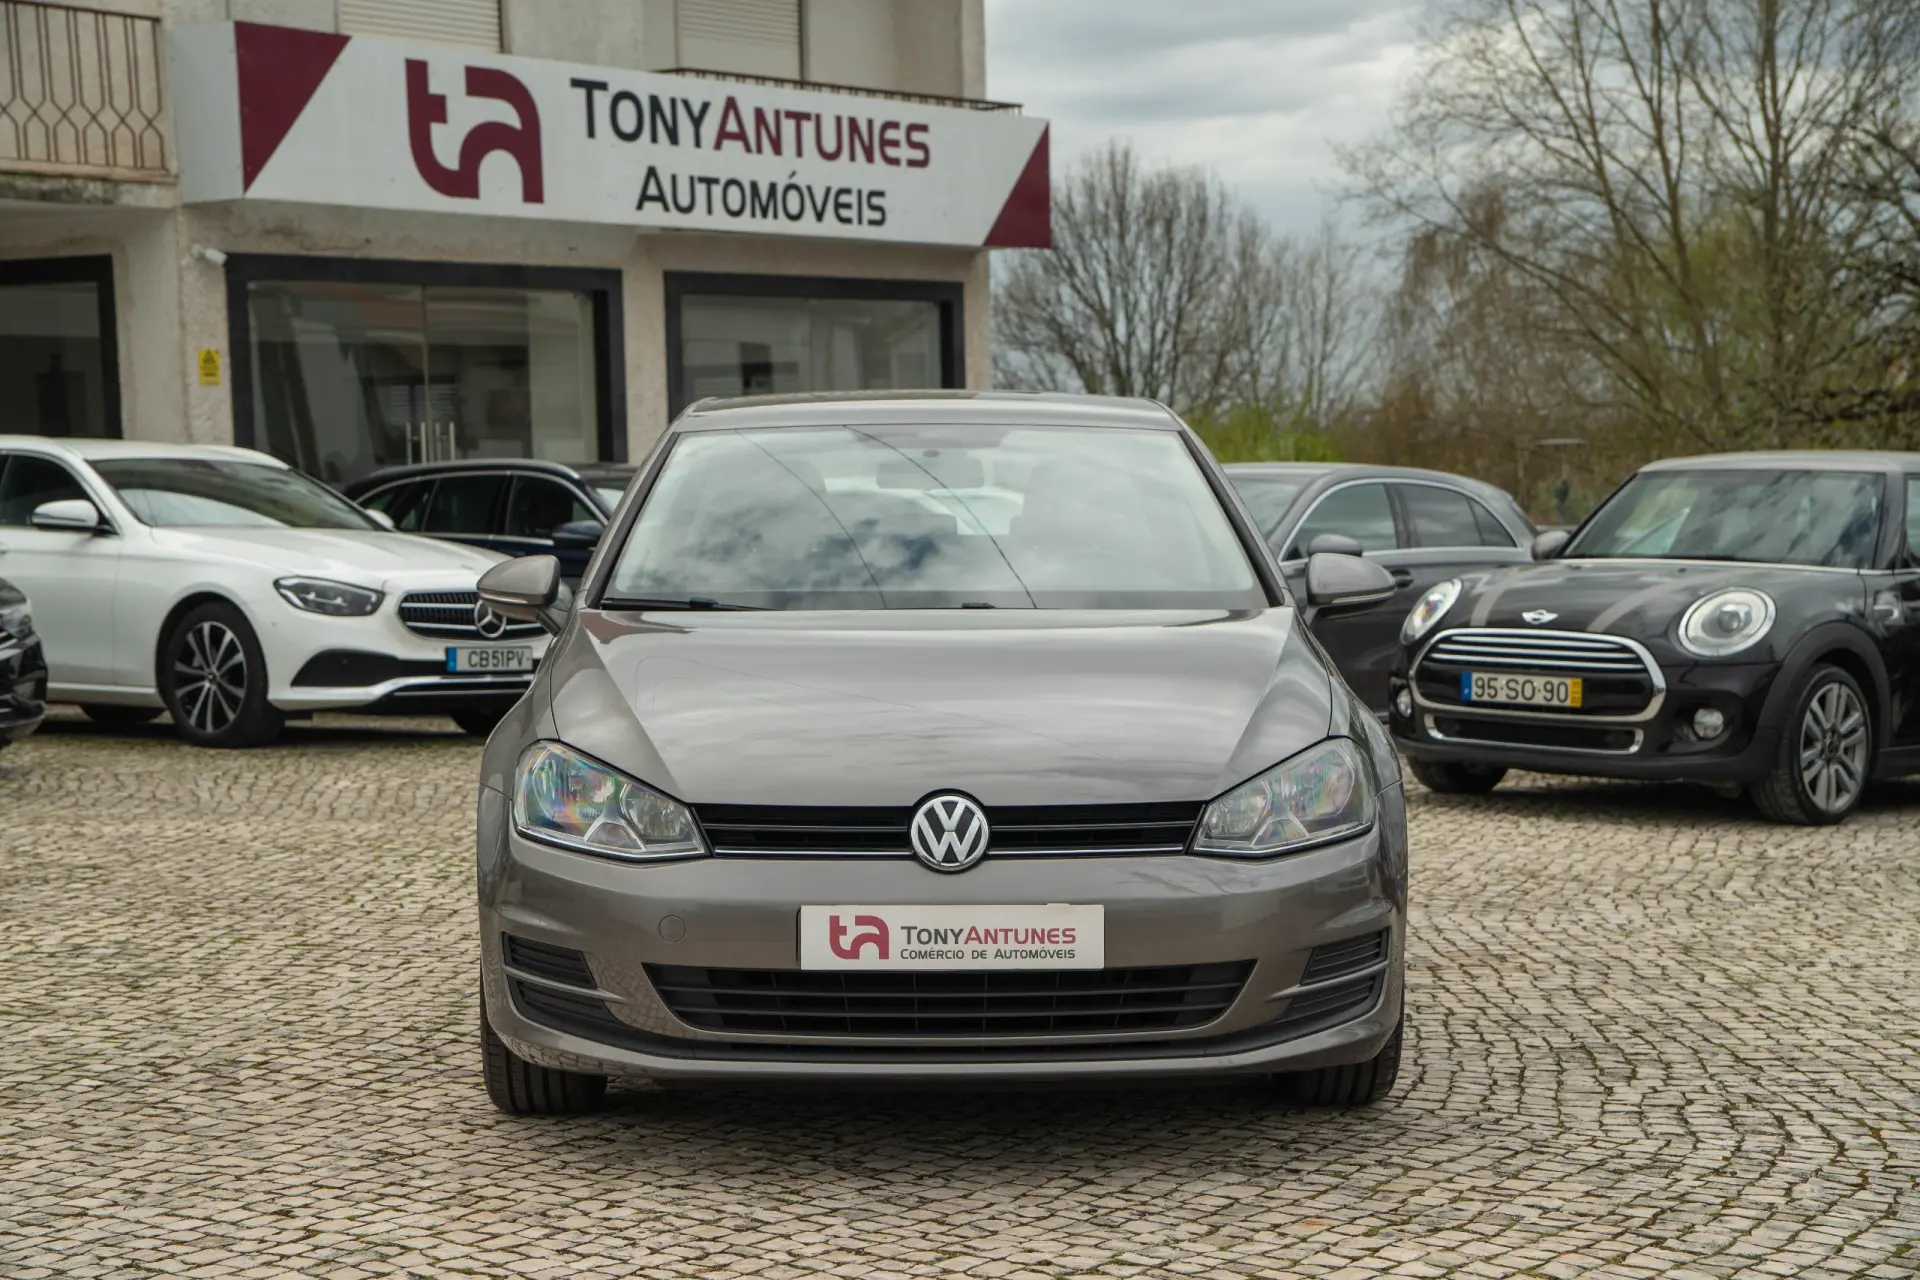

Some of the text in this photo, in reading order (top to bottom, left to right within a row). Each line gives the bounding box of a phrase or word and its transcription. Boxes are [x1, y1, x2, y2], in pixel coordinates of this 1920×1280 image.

[635, 165, 887, 227] AUTOMÓVEIS
[900, 947, 1076, 960] COMÉRCIO DE AUTOMÓVEIS
